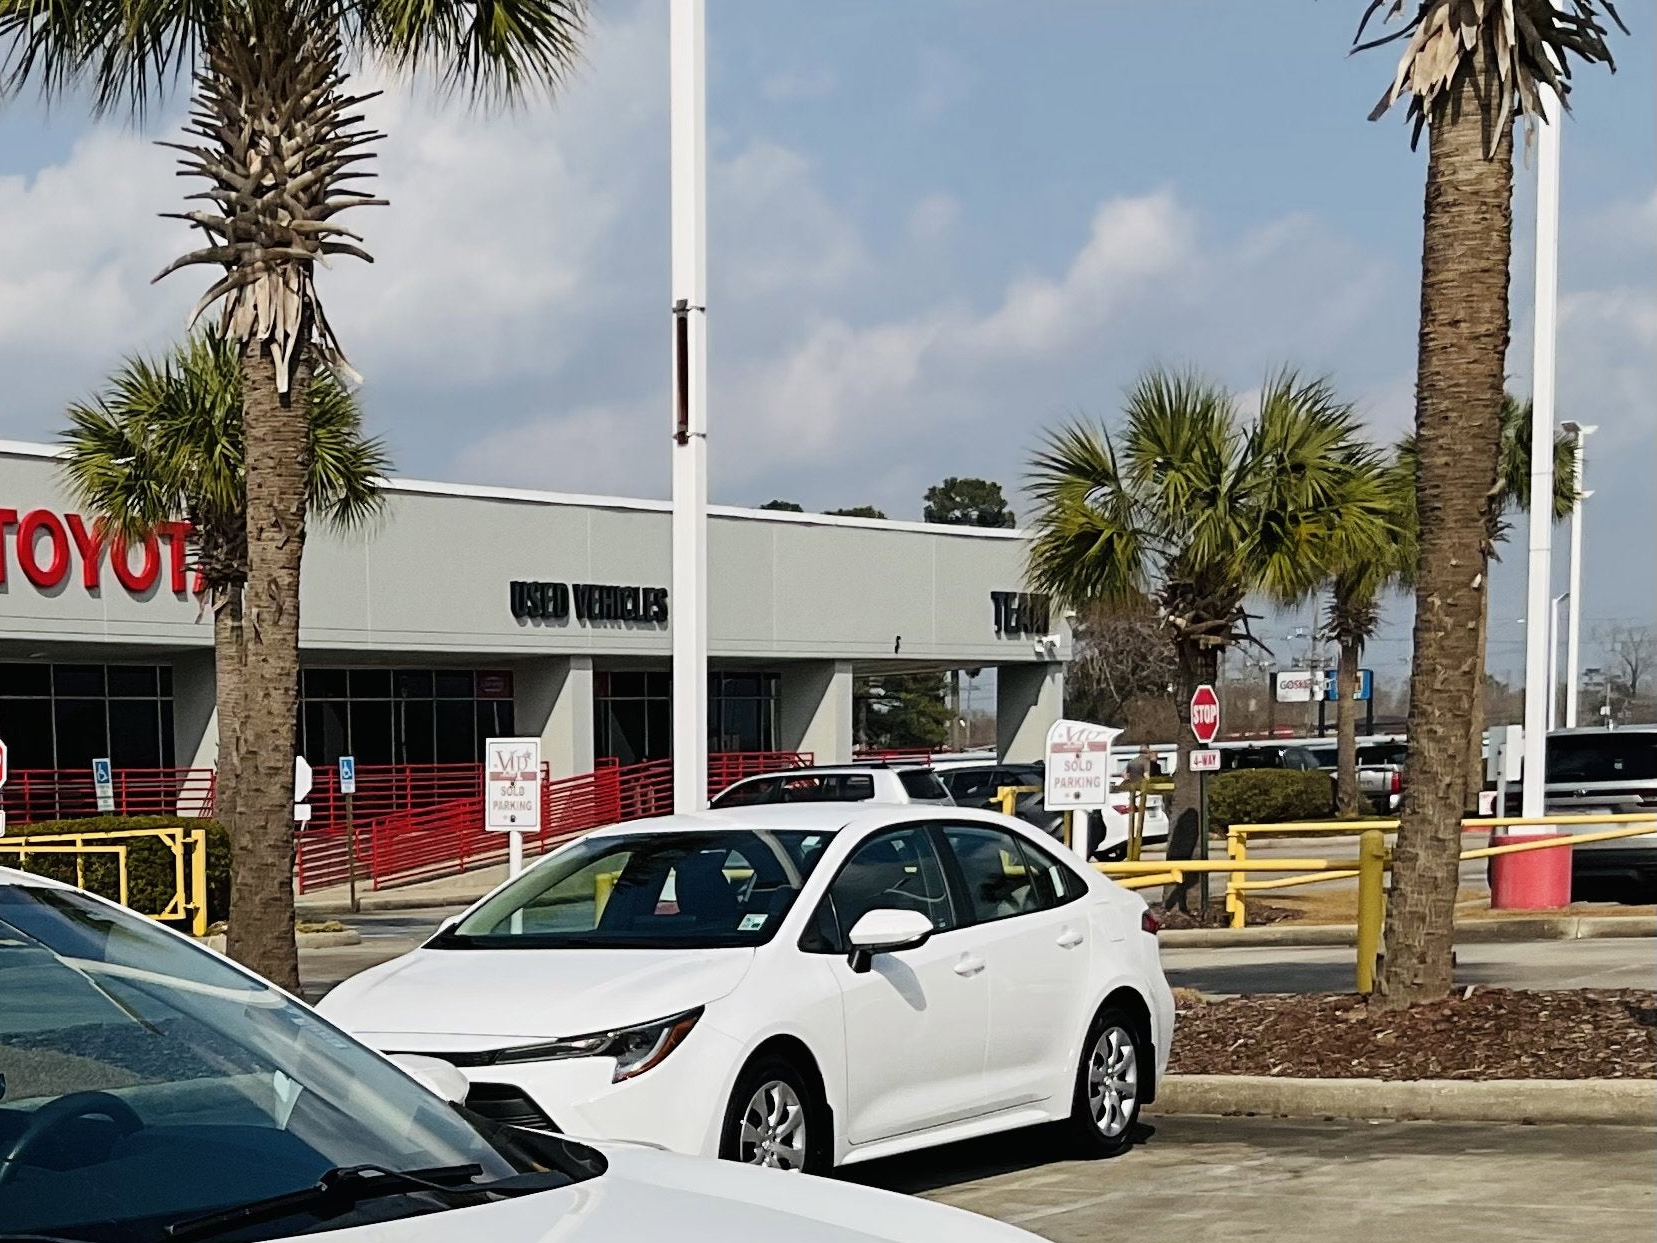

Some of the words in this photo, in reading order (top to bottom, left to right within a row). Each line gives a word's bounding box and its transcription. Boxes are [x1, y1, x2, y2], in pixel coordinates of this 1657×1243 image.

[509, 581, 570, 618] USED
[571, 584, 669, 623] VEHICLES
[1193, 704, 1217, 724] STOP
[1064, 760, 1093, 772] SOLD
[1193, 755, 1217, 766] 4-WAY
[1053, 777, 1101, 789] PARKING
[500, 785, 525, 797] SOLD
[492, 801, 533, 811] PARKING
